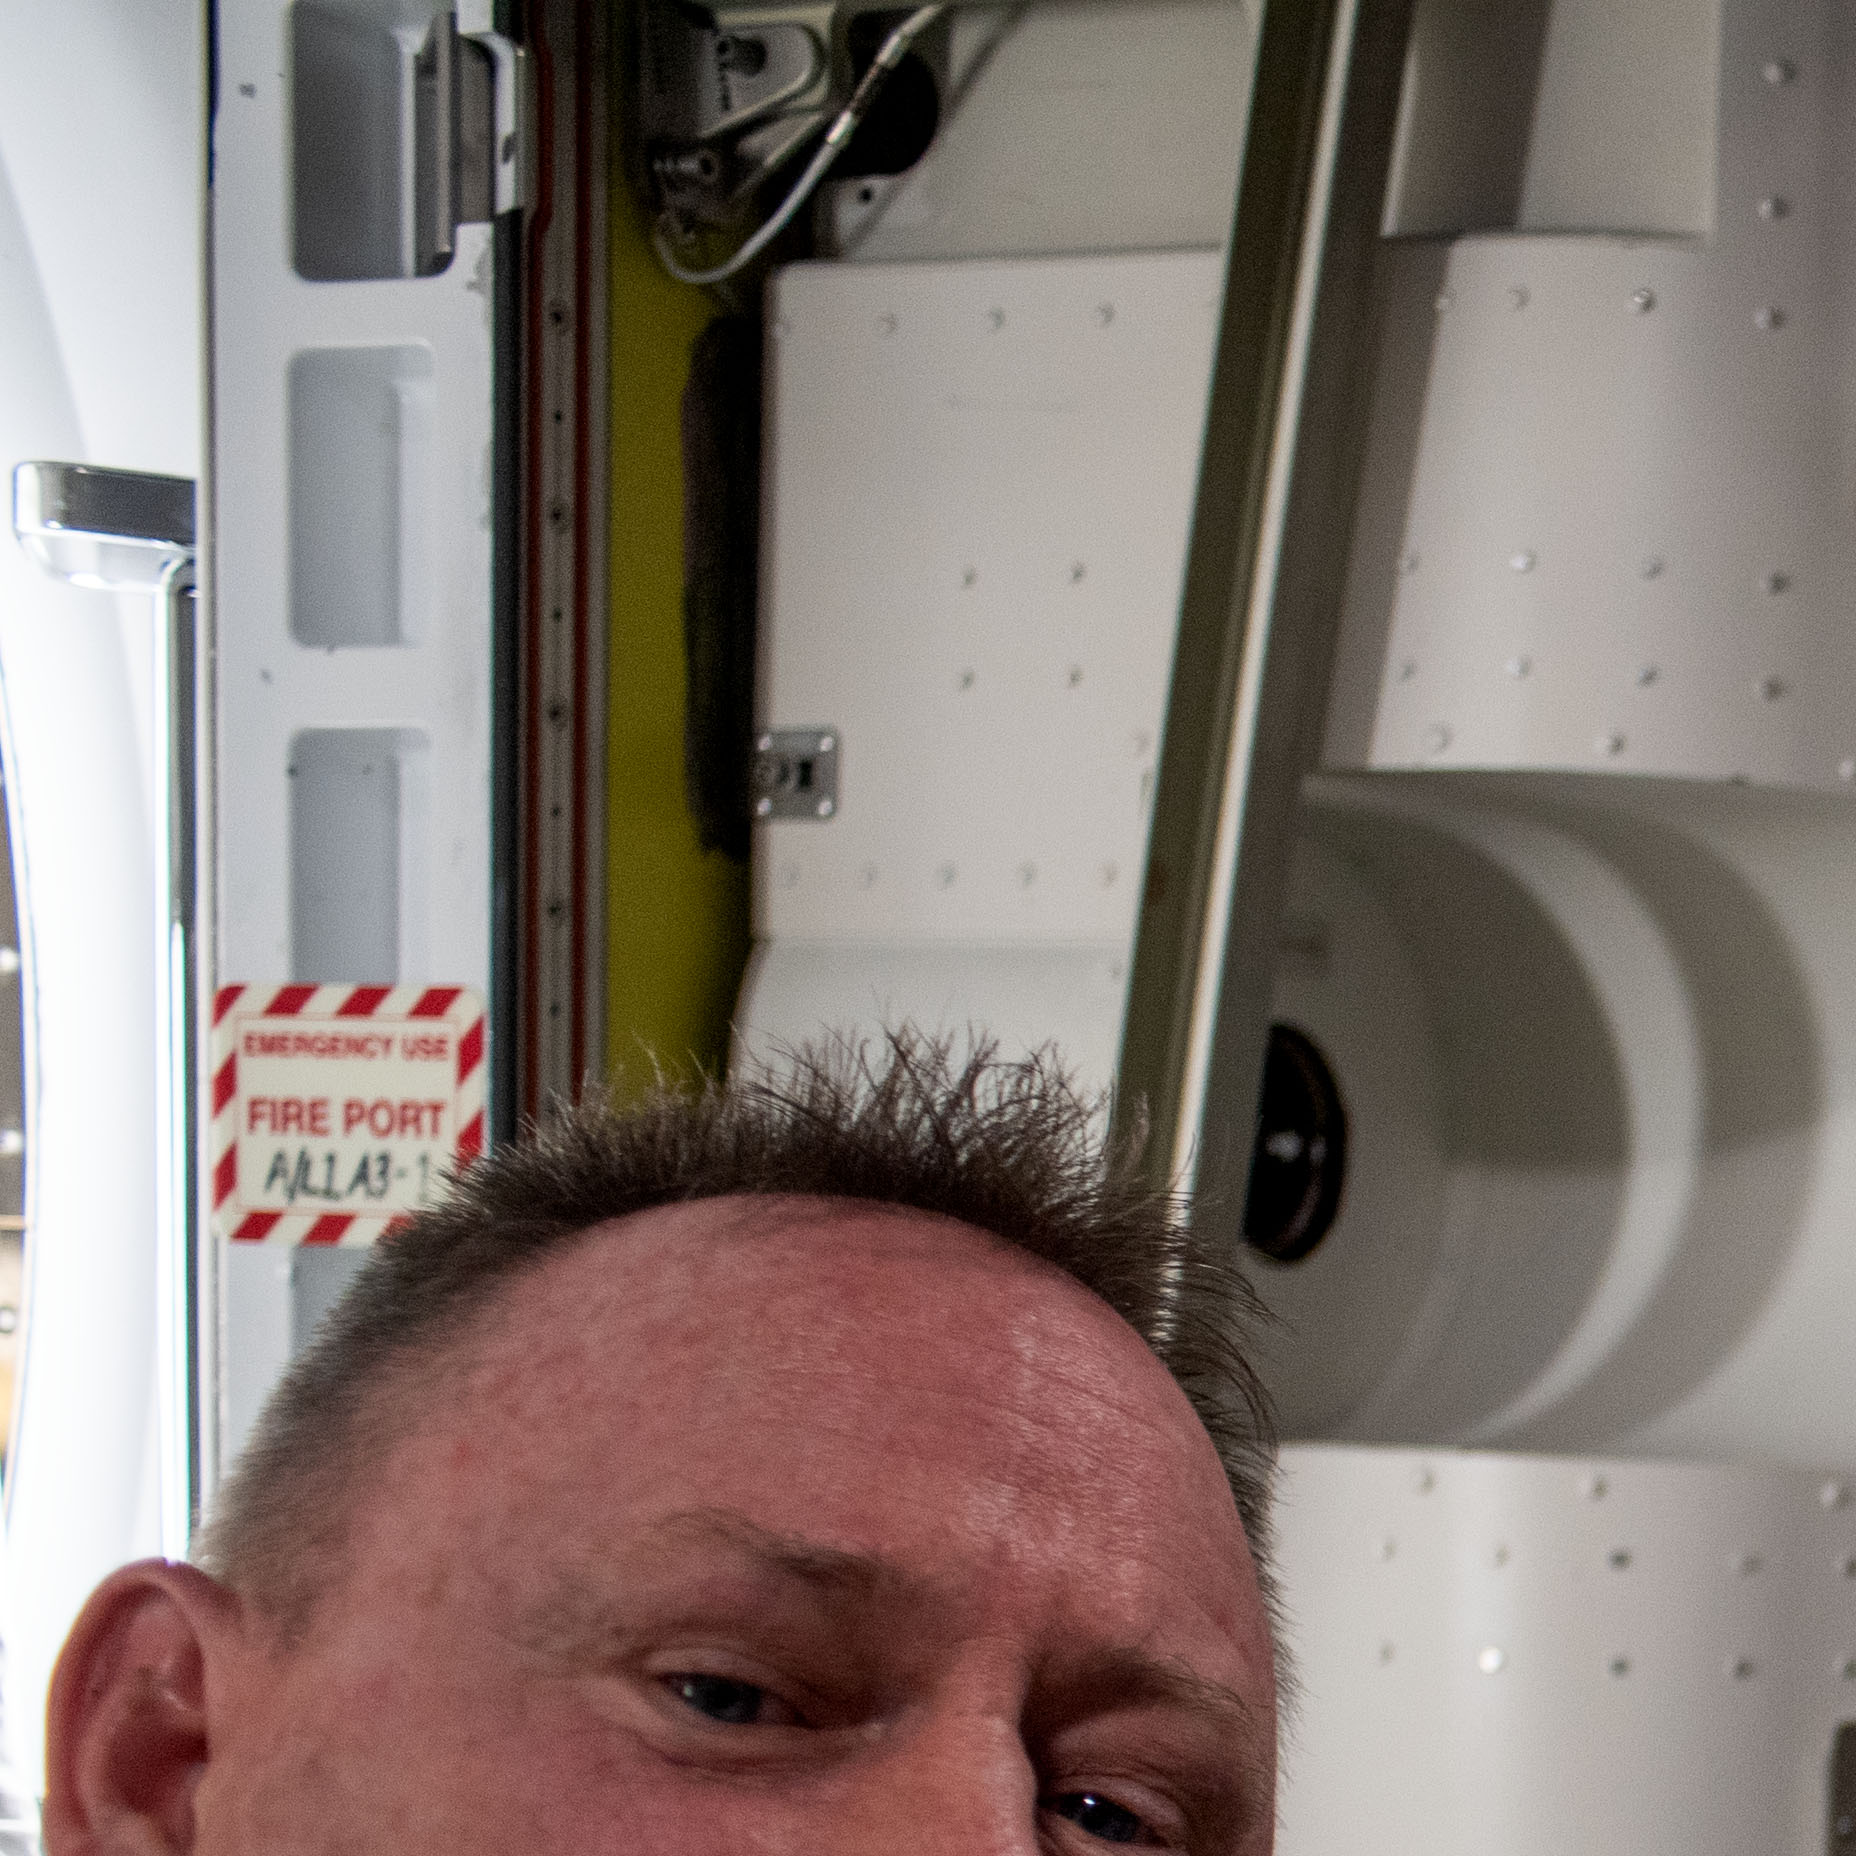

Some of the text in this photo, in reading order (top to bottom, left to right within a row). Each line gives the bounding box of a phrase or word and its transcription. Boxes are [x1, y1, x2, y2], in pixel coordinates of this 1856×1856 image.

[244, 1035, 450, 1060] EMERGENCY USE
[248, 1098, 445, 1138] FIRE PORT
